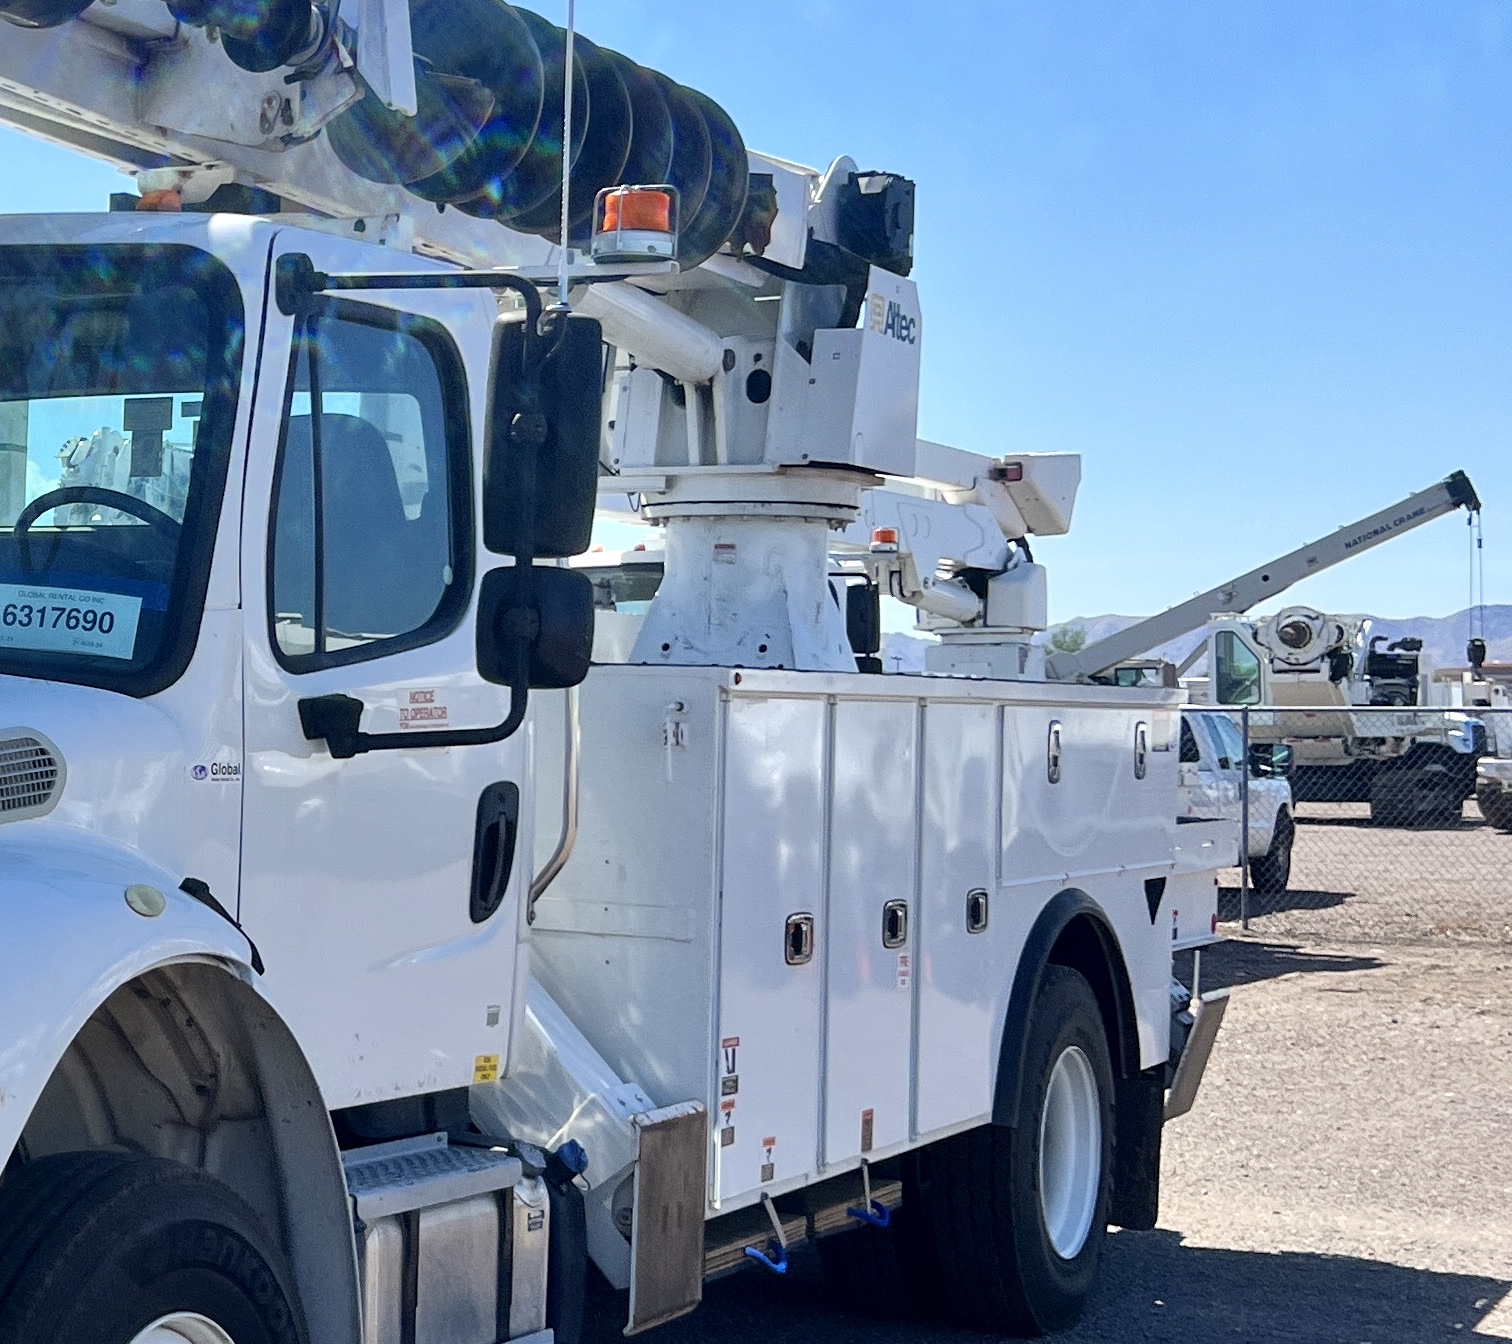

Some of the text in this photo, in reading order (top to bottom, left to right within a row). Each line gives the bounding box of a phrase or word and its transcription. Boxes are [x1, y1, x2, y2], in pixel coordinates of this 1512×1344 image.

[884, 300, 916, 345] Altec
[1344, 523, 1392, 550] NATIONAL
[1393, 506, 1426, 528] CRANE
[48, 593, 77, 602] RENTAL
[2, 603, 115, 635] 6317690
[210, 762, 241, 776] Global
